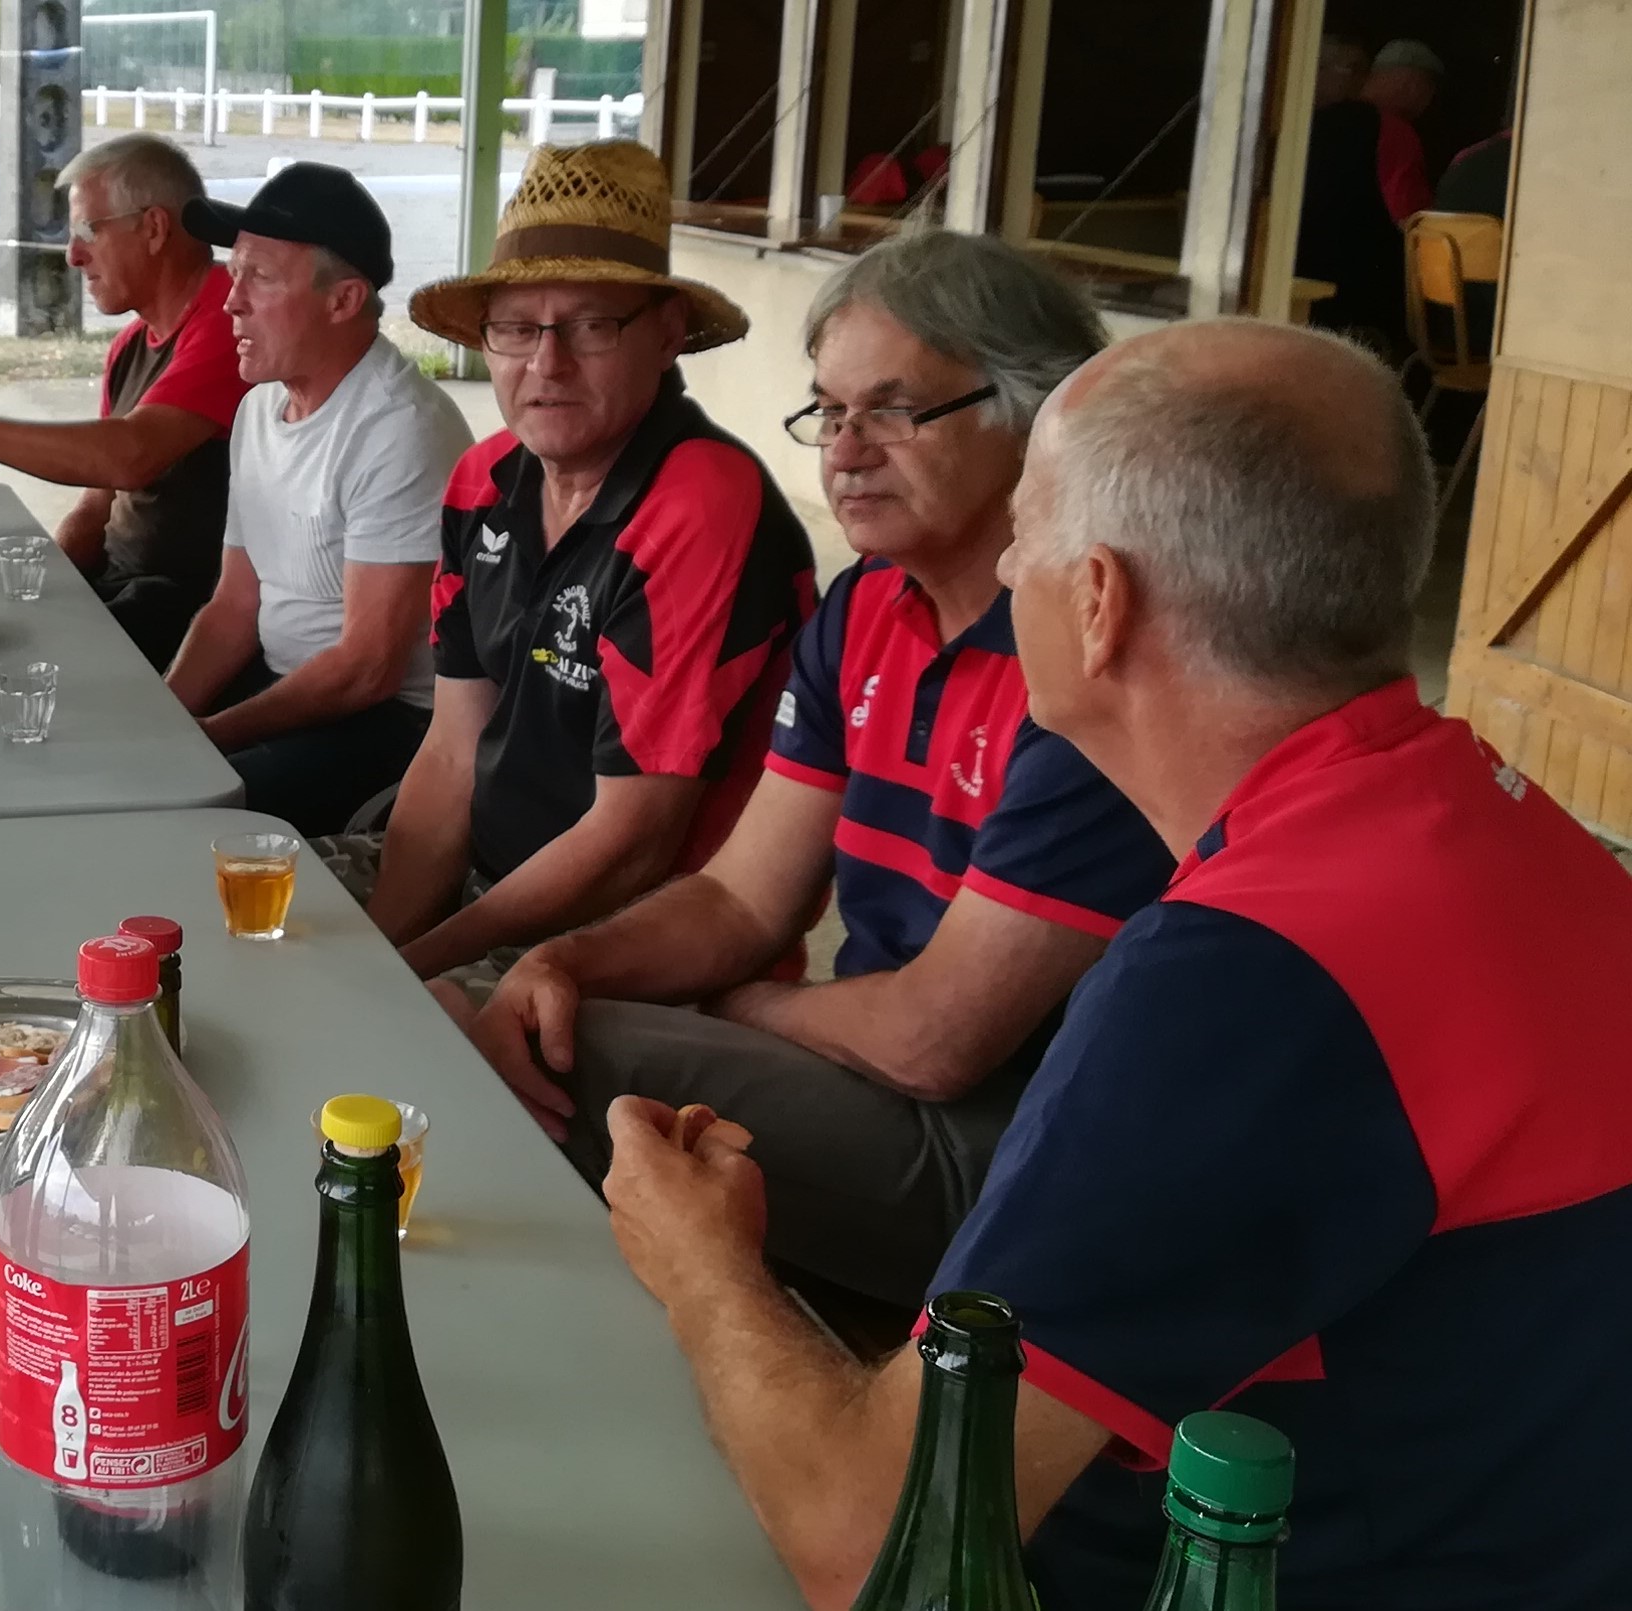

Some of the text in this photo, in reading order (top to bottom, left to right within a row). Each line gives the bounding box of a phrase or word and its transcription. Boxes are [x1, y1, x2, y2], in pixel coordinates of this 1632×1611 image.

[61, 1404, 78, 1427] 8
[94, 1458, 132, 1468] PENSEZ
[95, 1466, 109, 1475] AU
